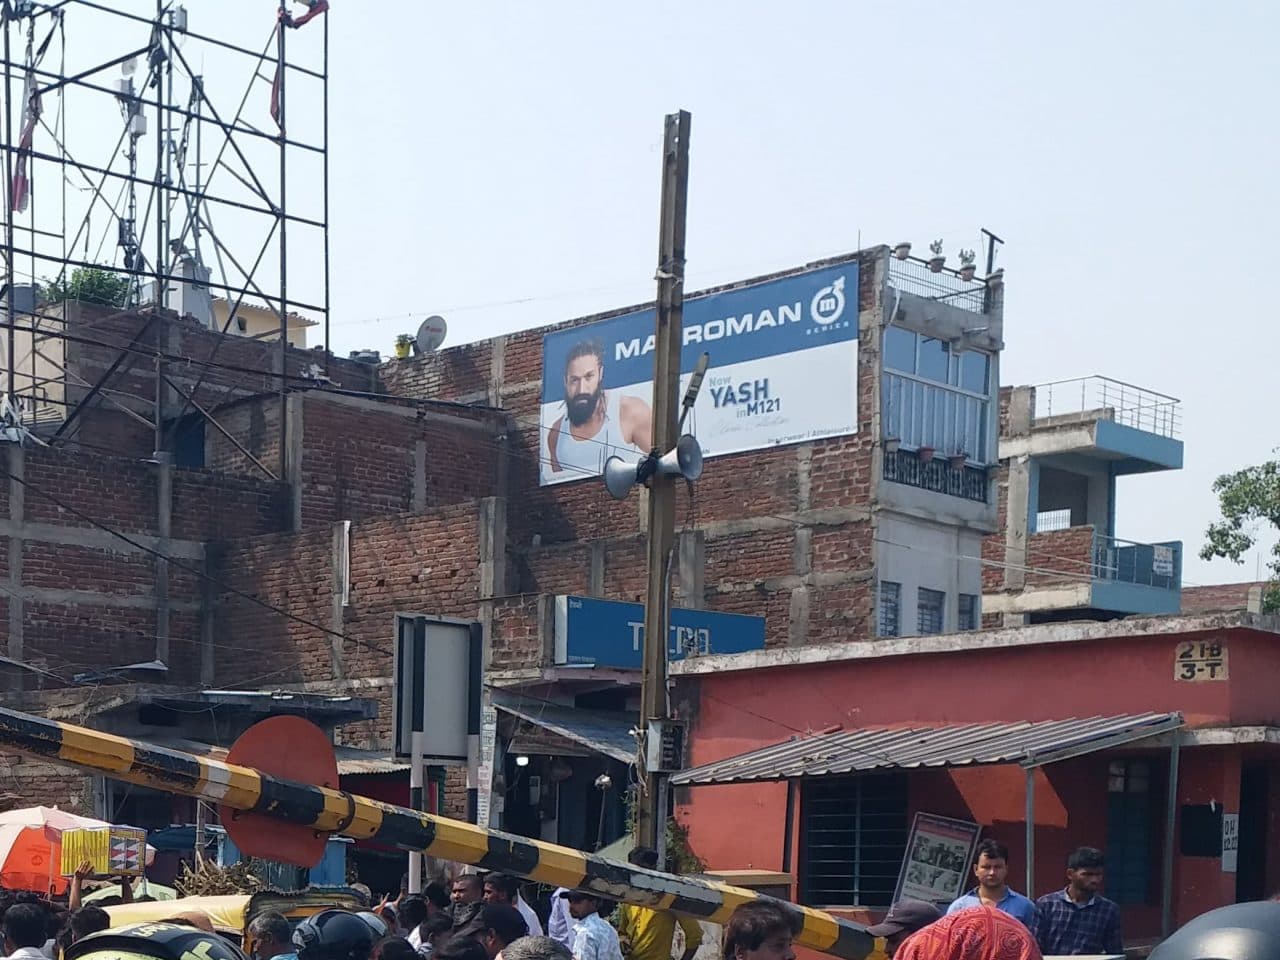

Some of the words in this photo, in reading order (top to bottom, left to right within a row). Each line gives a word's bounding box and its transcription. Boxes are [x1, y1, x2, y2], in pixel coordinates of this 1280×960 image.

[615, 301, 802, 360] MAROMAN
[709, 375, 732, 387] Now
[710, 378, 769, 409] YASH
[747, 398, 780, 417] M121
[1180, 662, 1222, 680] 3-T
